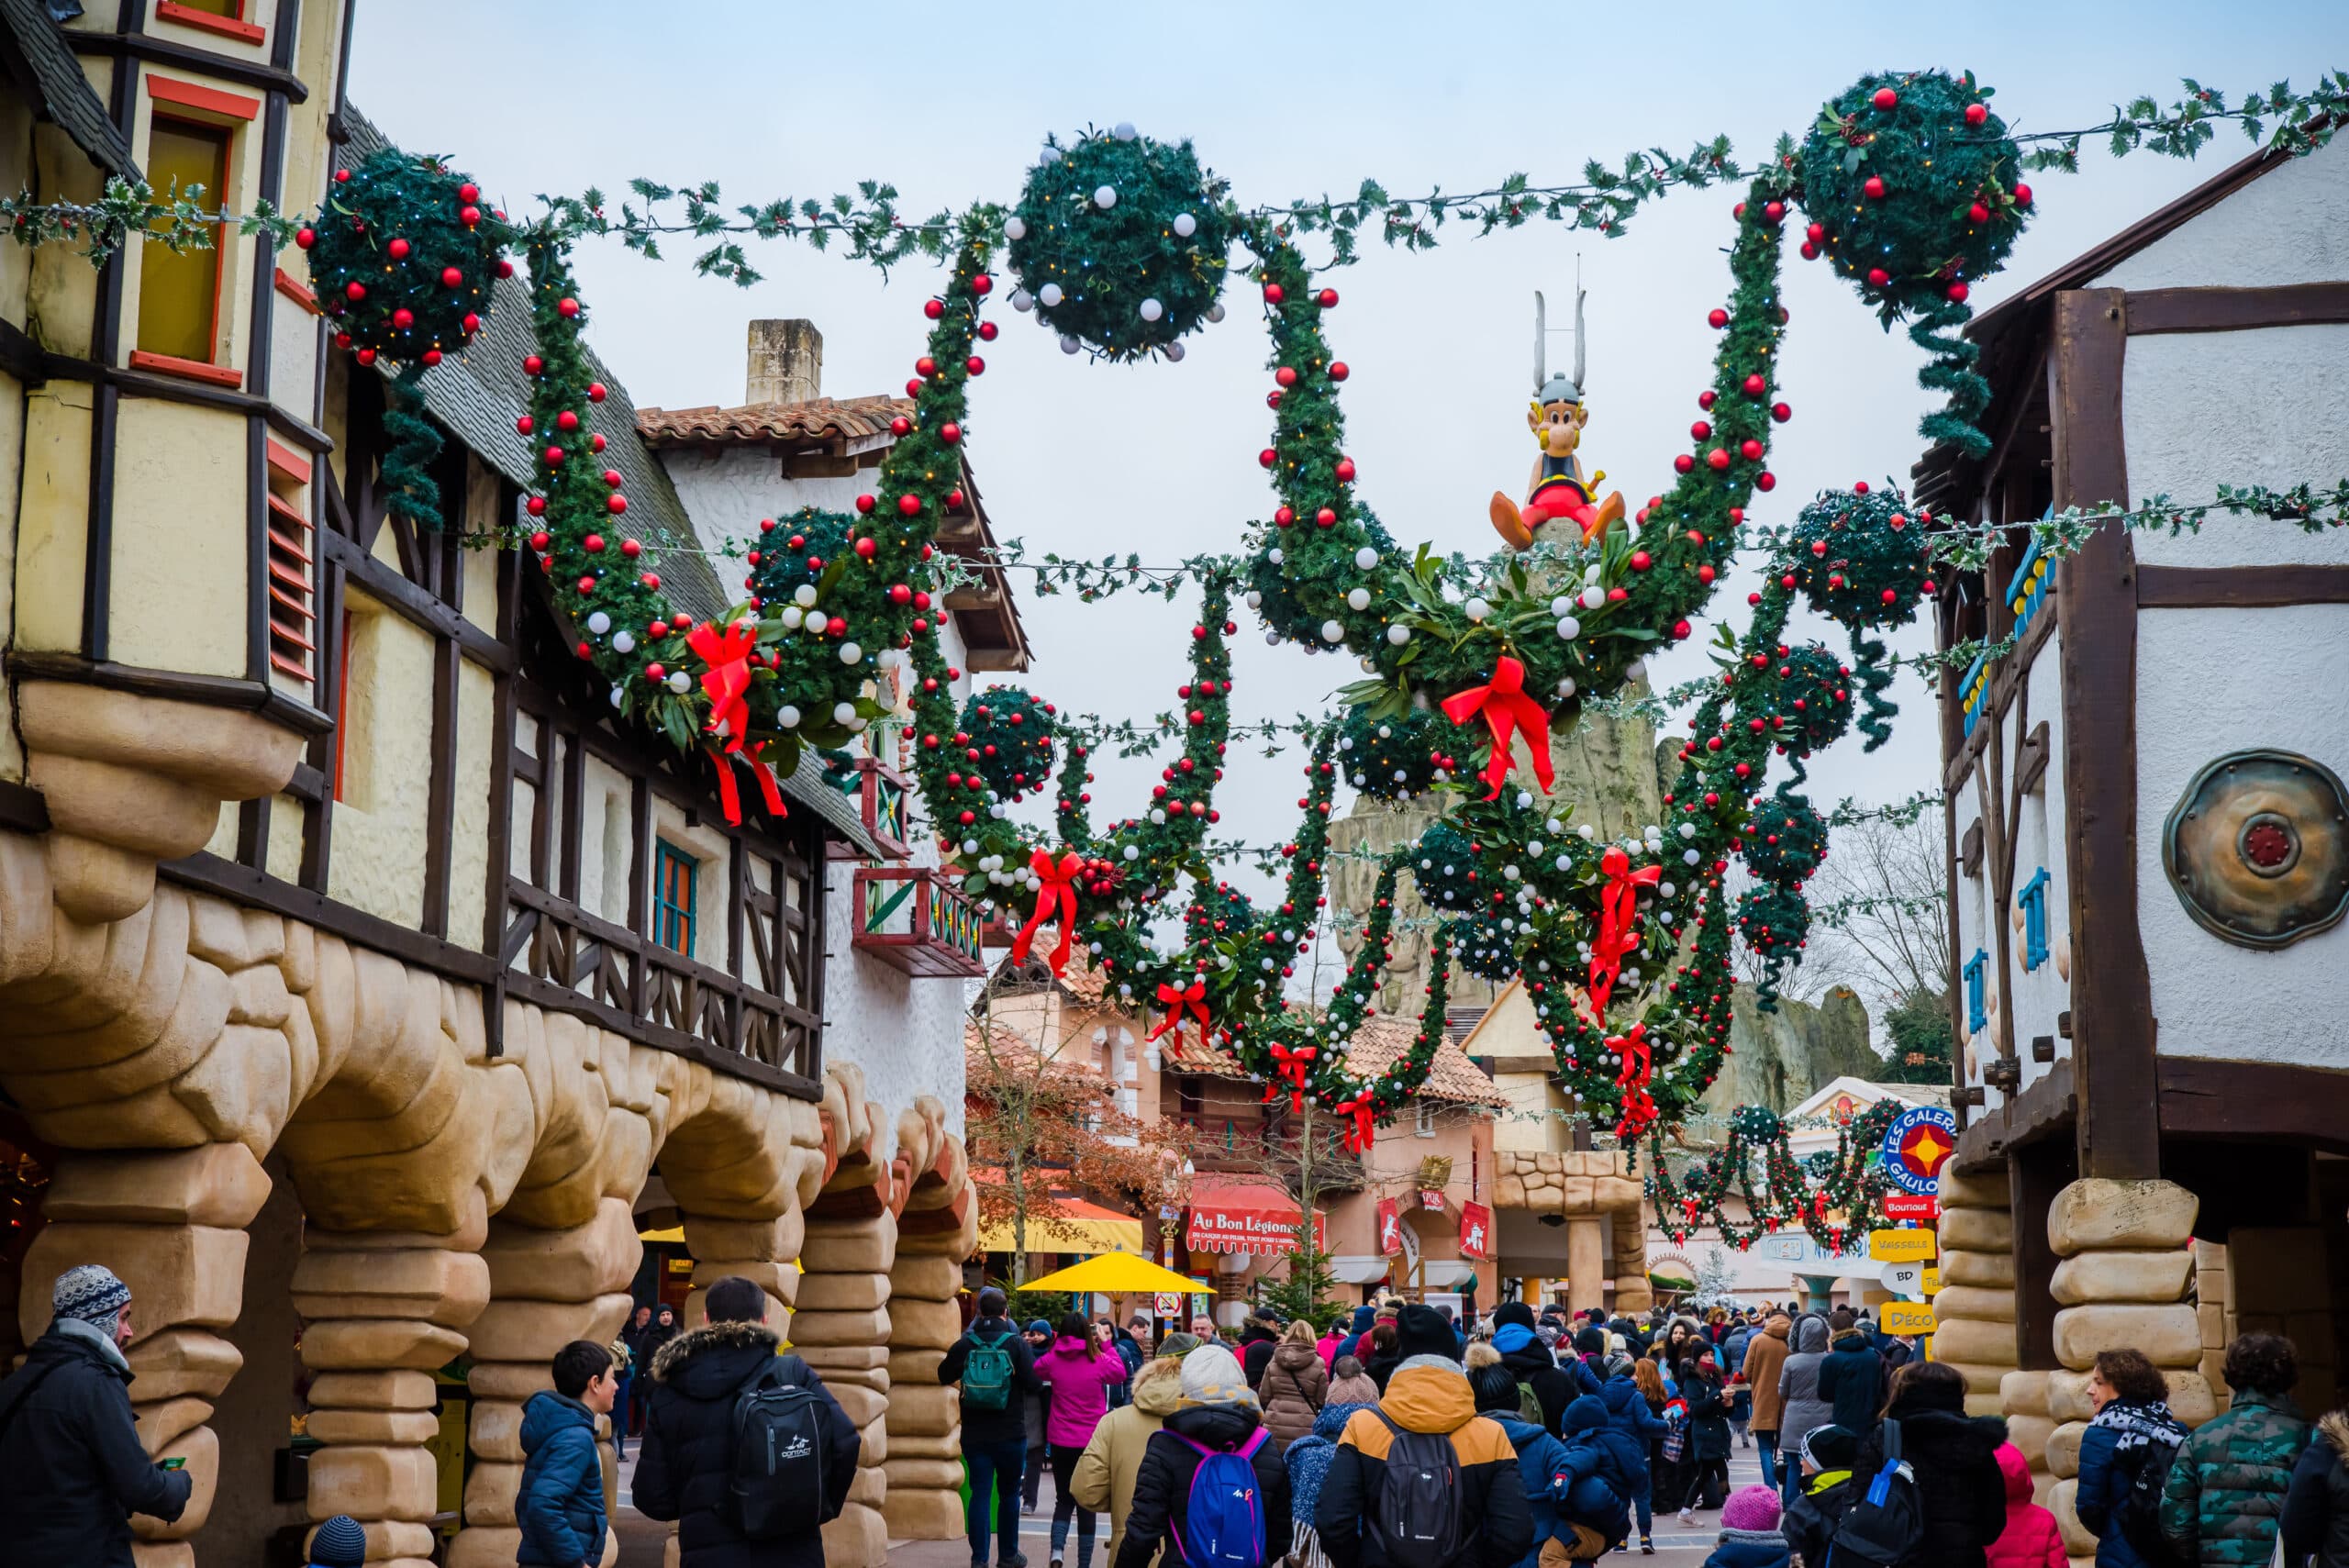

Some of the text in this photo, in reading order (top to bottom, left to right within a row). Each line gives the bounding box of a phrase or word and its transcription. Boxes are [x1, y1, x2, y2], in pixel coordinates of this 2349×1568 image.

[1887, 1109, 1958, 1154] LES GALERI
[1890, 1162, 1938, 1192] GAULO
[1193, 1212, 1213, 1230] Au
[1217, 1214, 1243, 1230] Bon
[1897, 1271, 1913, 1282] BD
[1891, 1312, 1933, 1328] DÉCO
